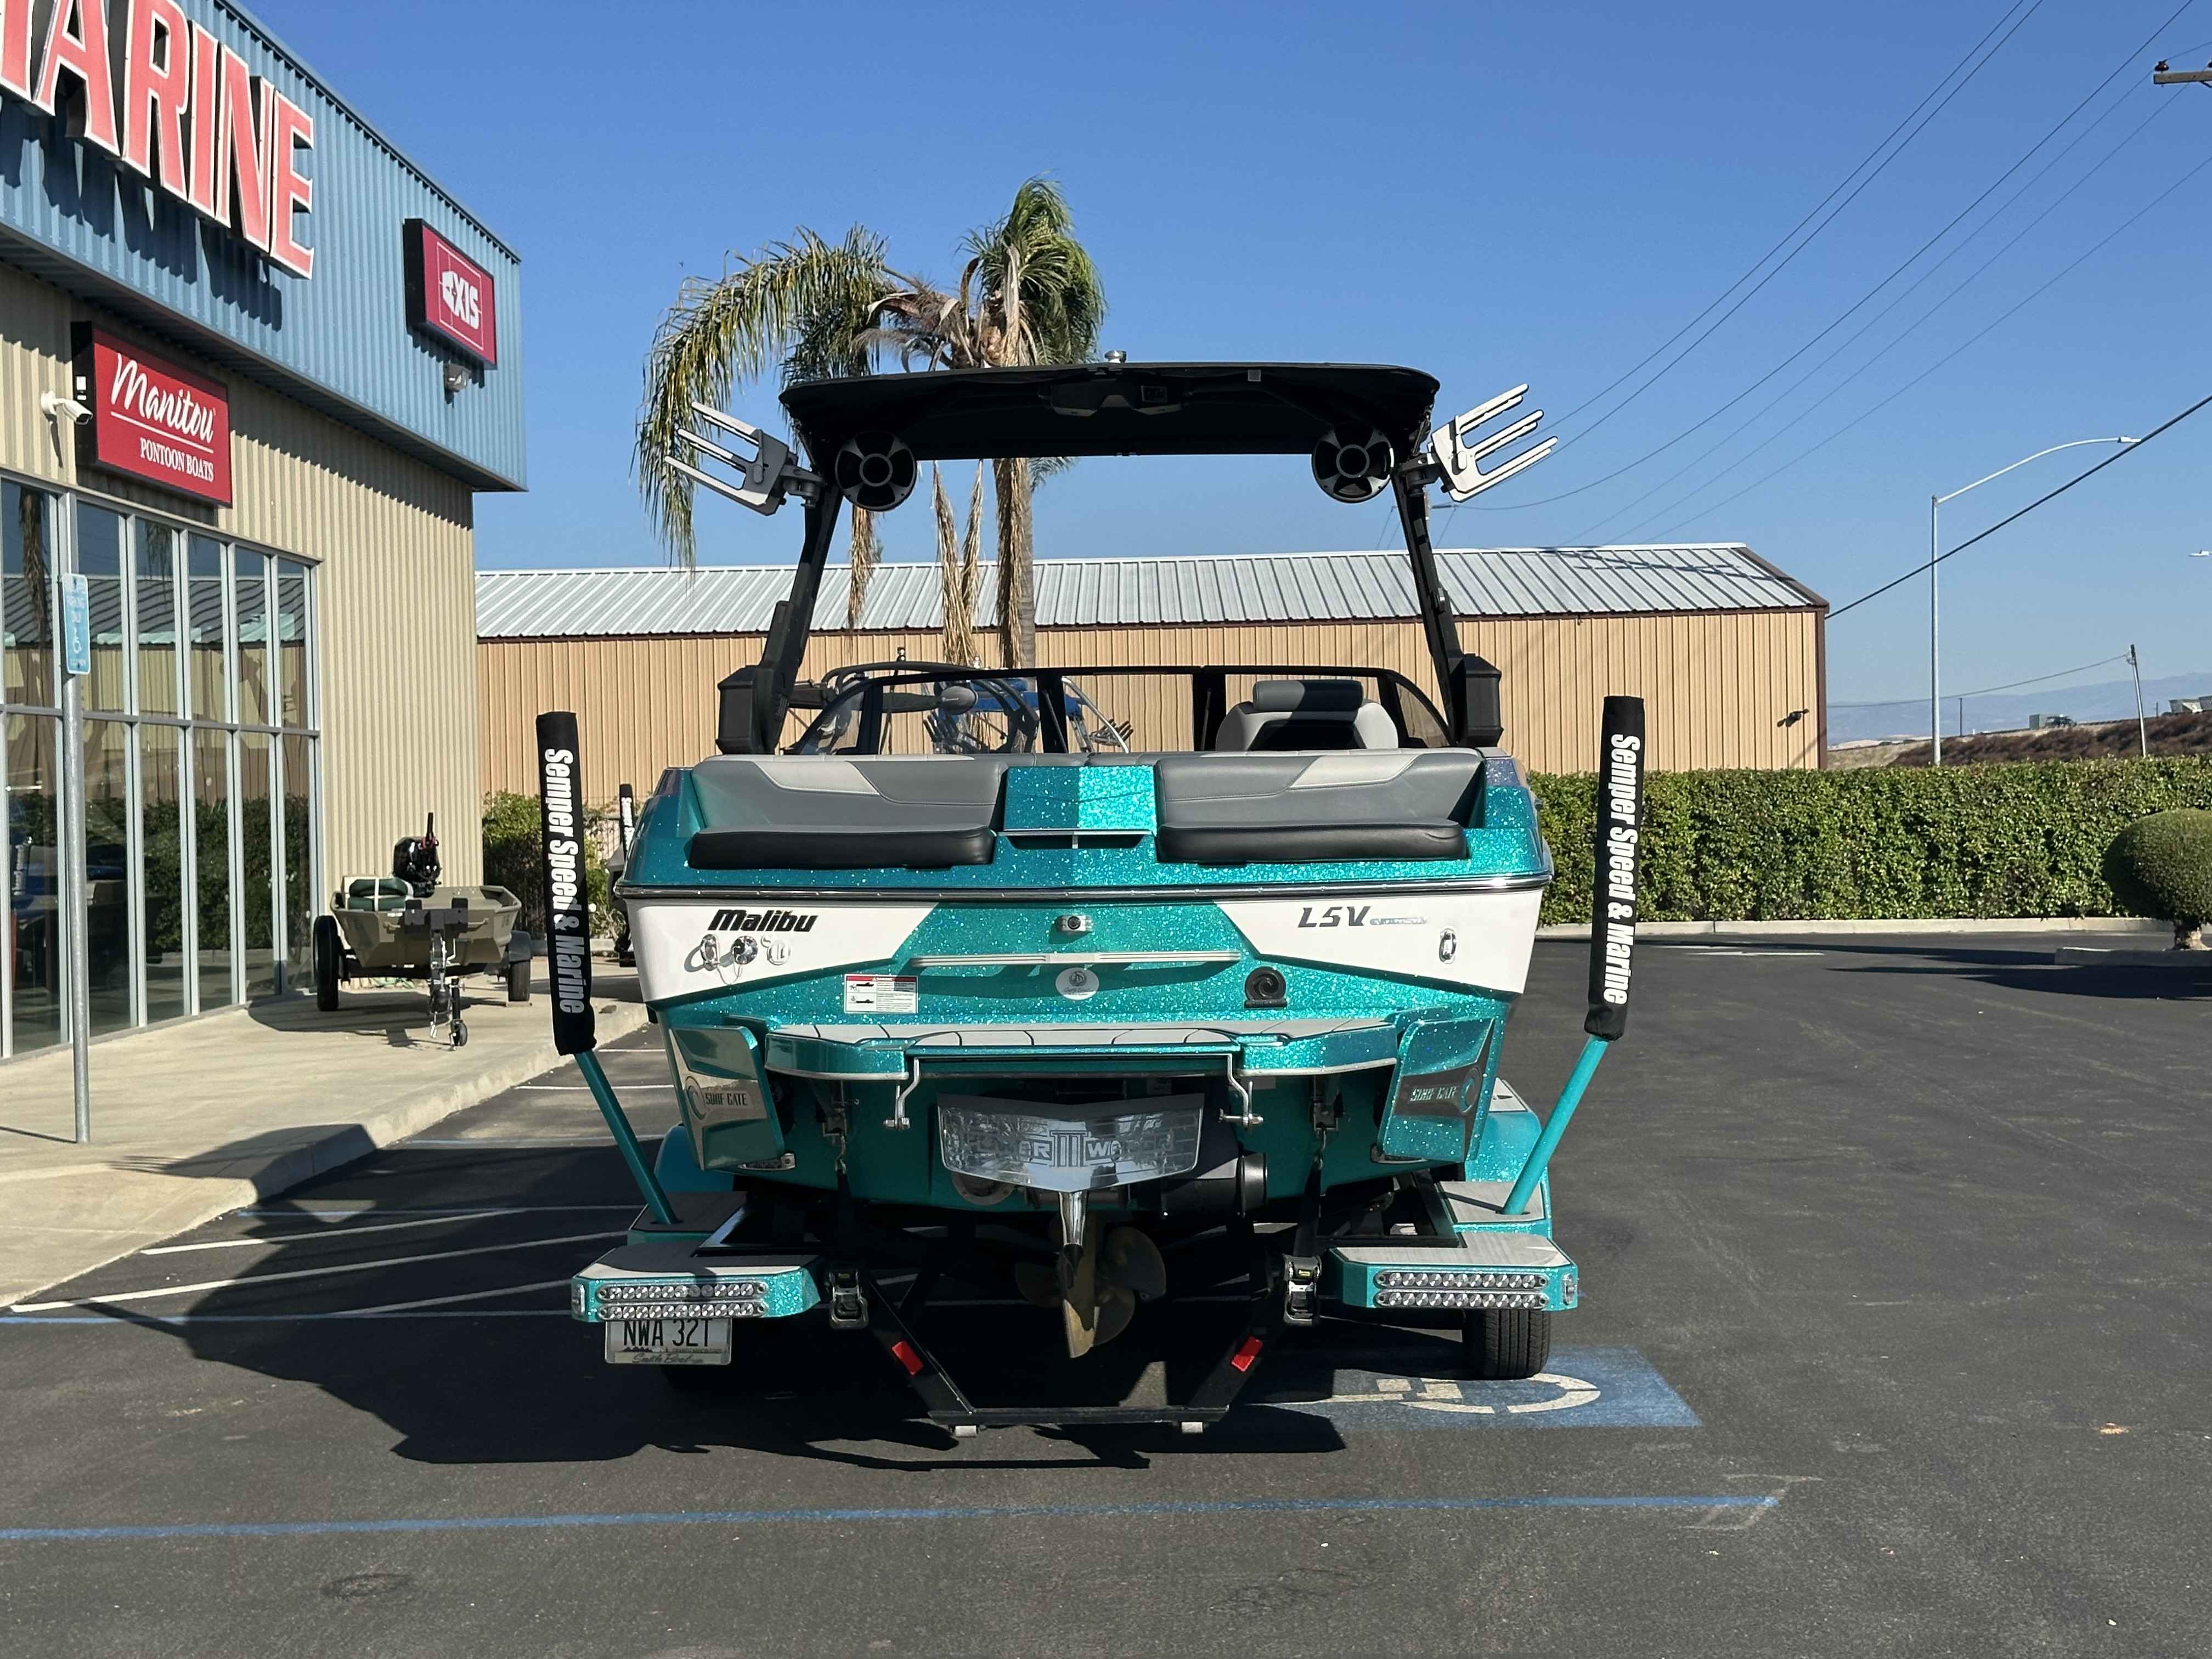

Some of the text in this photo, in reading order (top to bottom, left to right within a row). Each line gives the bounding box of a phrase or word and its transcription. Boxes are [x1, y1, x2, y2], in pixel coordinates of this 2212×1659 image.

[0, 0, 314, 280] ARINE
[111, 353, 214, 443] Manitou
[140, 437, 214, 483] PONTOON BOATS
[545, 748, 587, 1013] Semper Speed & Marine
[1603, 733, 1641, 1005] Semper Speed & Marine
[707, 909, 819, 932] Malibu
[1297, 906, 1371, 928] LSV
[704, 1092, 748, 1105] SURF GATE
[623, 1320, 663, 1346] NWA
